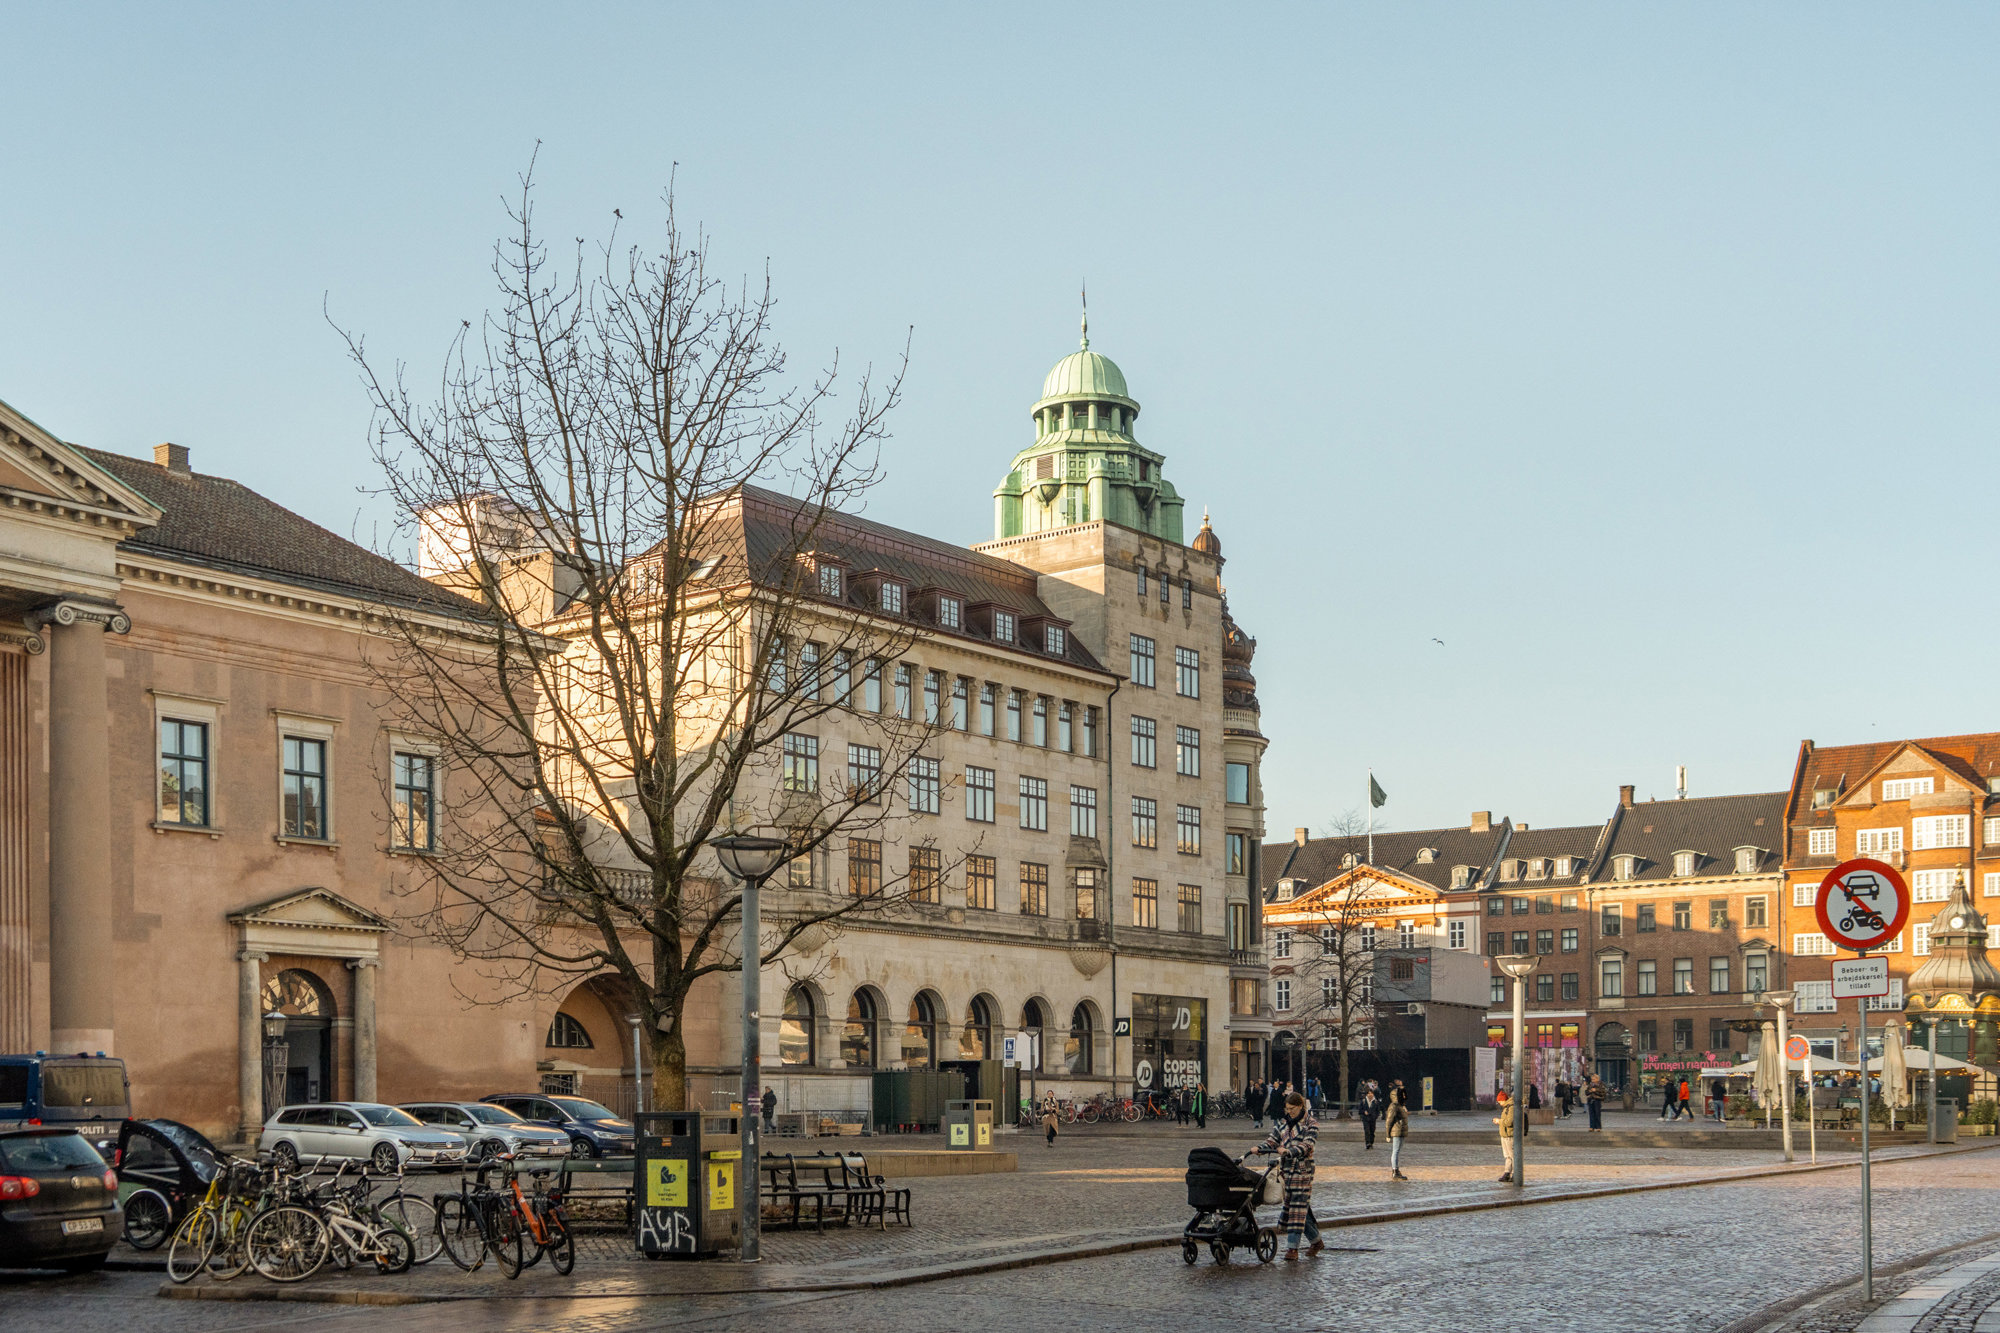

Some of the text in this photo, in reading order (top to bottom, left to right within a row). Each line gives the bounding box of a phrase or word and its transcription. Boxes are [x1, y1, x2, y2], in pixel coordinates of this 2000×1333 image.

[1837, 973, 1883, 982] arbejdskørsel
[1172, 1007, 1191, 1030] JD
[1115, 1021, 1129, 1033] JD
[1139, 1066, 1151, 1081] JD
[1163, 1060, 1201, 1074] COPEN
[1163, 1074, 1201, 1088] HAGEN
